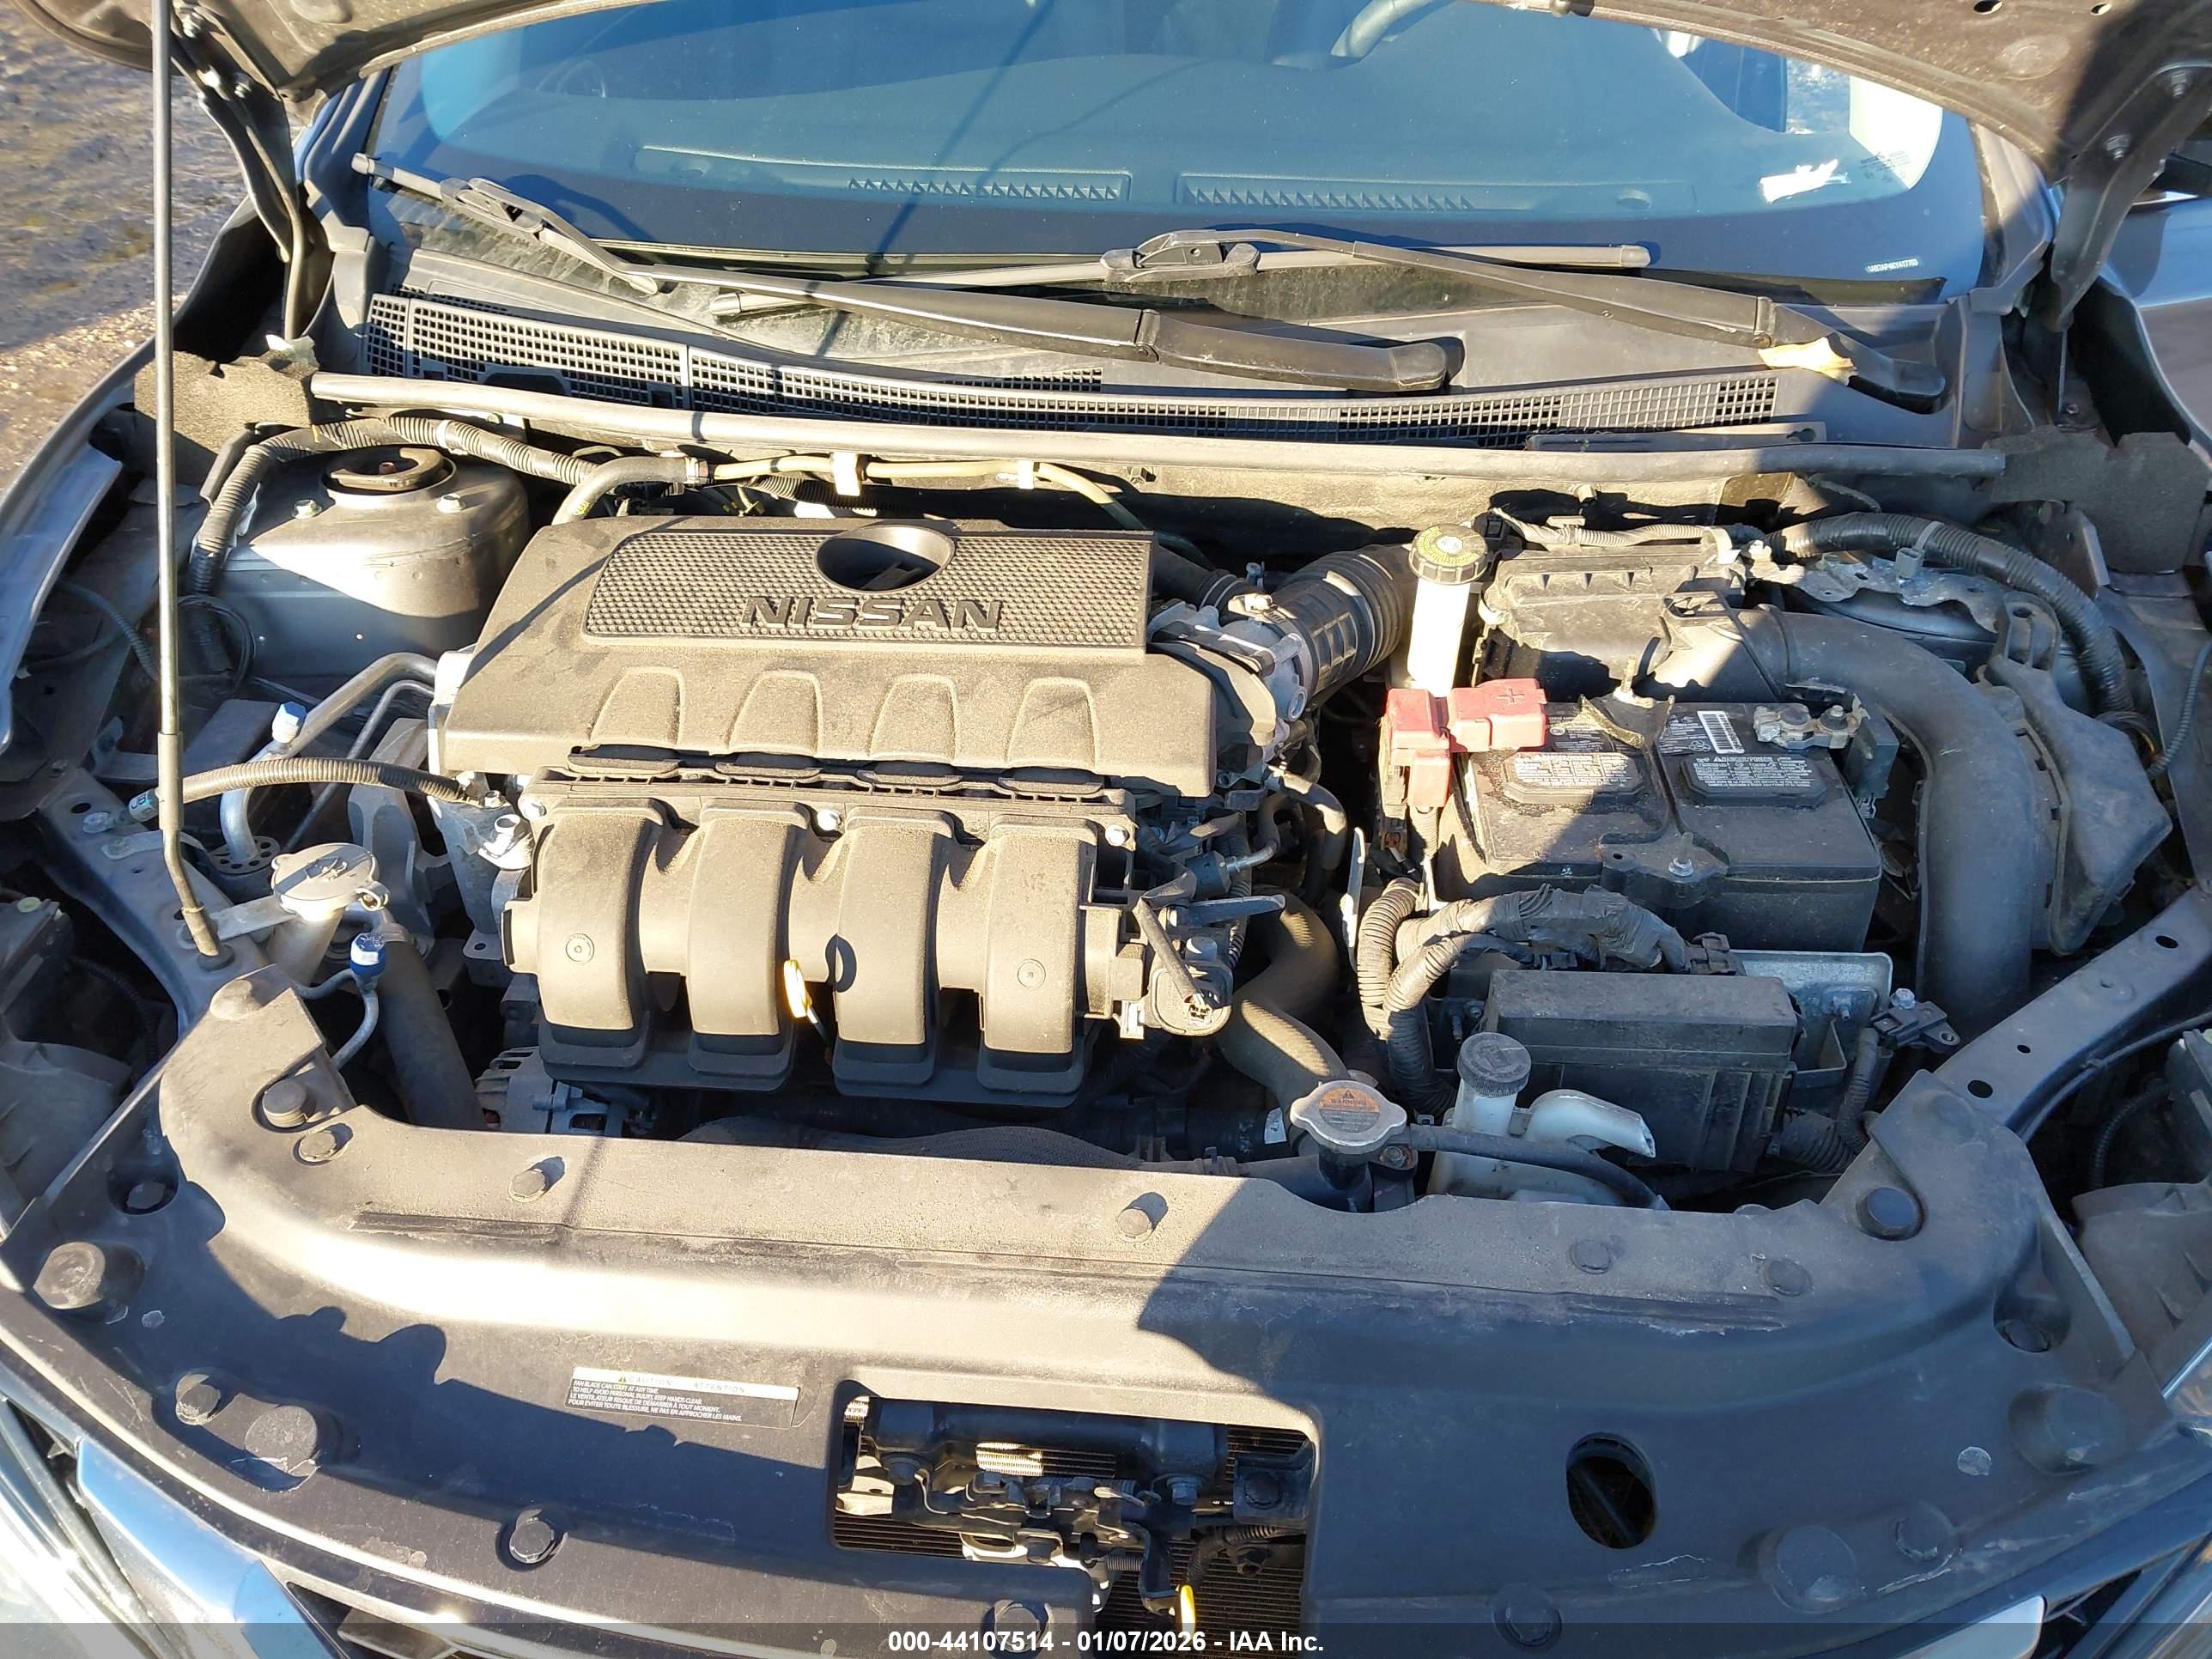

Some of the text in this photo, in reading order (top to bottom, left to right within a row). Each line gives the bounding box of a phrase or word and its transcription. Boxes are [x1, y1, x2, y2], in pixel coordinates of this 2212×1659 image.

[741, 596, 1003, 630] NISSAN
[629, 1376, 672, 1386] CAUTION
[694, 1382, 744, 1392] ATTENTION
[577, 1393, 612, 1401] VENTILATEUR
[678, 1409, 712, 1418] APPROCHER
